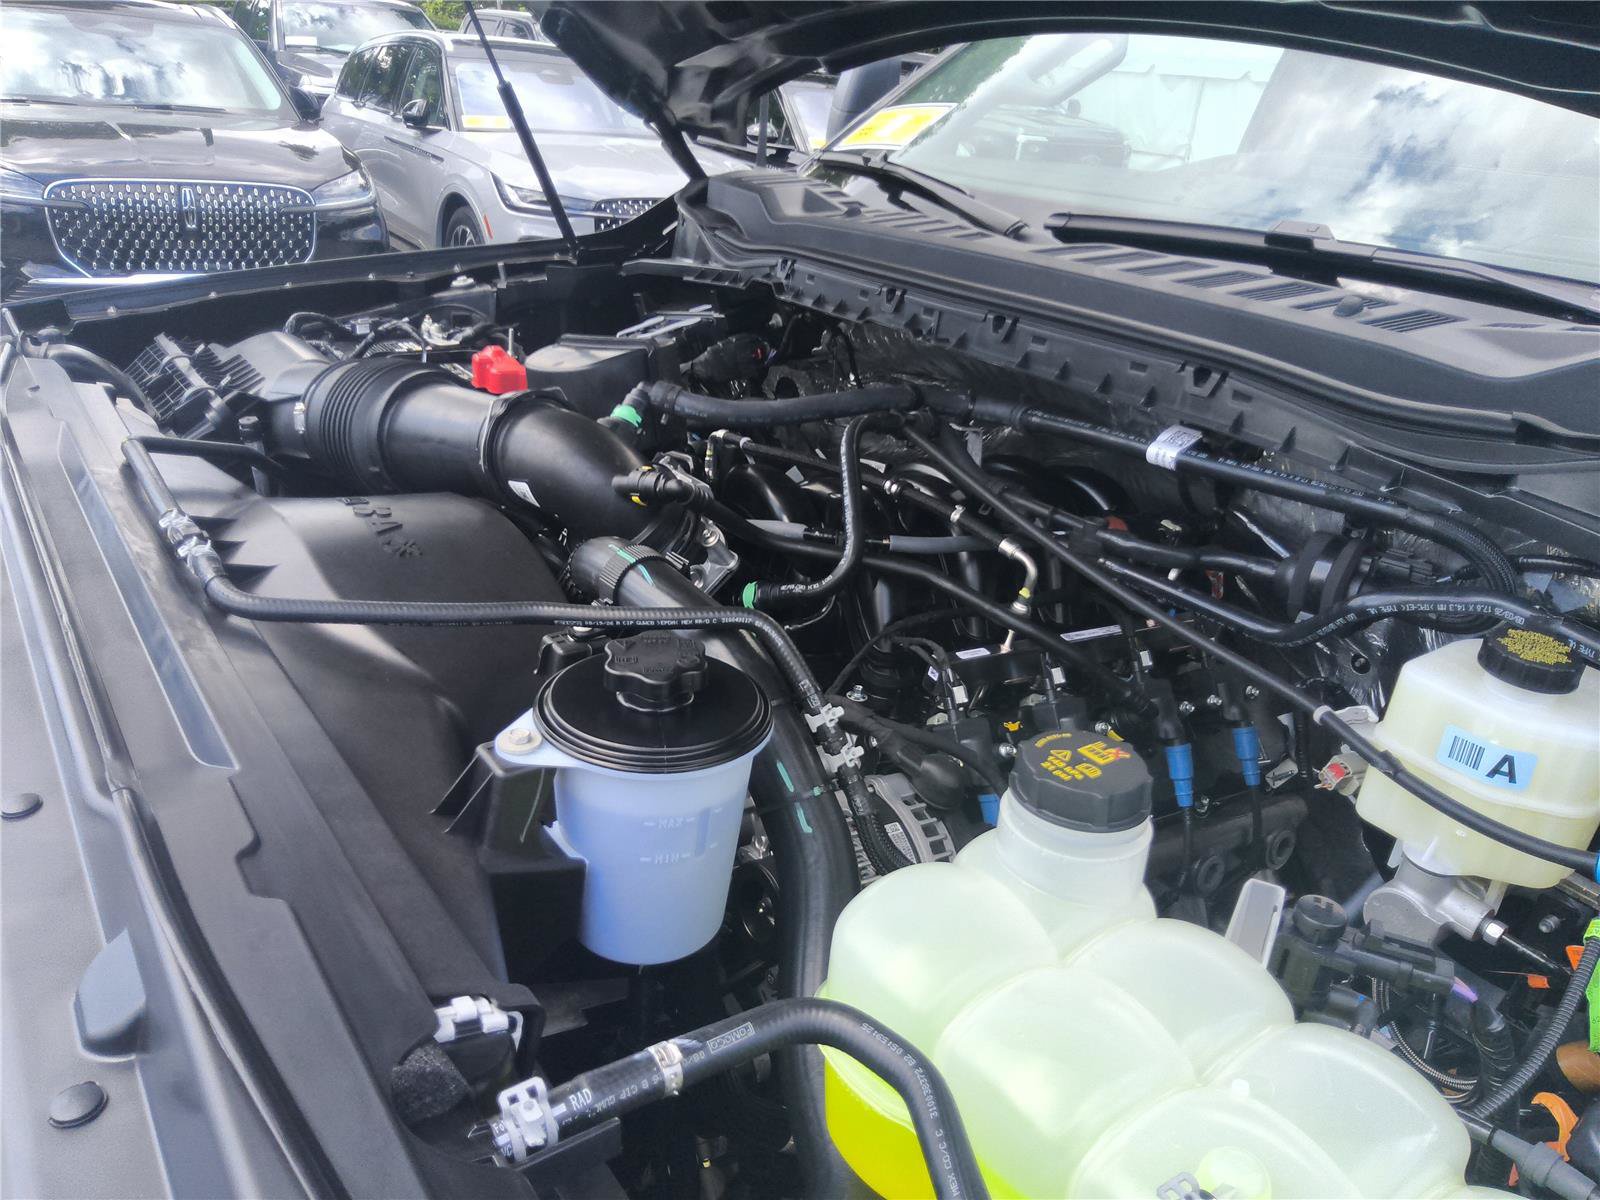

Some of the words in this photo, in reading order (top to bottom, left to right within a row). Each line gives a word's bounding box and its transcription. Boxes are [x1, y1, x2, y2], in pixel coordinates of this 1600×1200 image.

[1486, 754, 1517, 784] A
[658, 816, 684, 829] MAX
[654, 852, 680, 865] MIN
[569, 1087, 593, 1112] RAD
[935, 1128, 944, 1138] C
[947, 1172, 961, 1198] MEX
